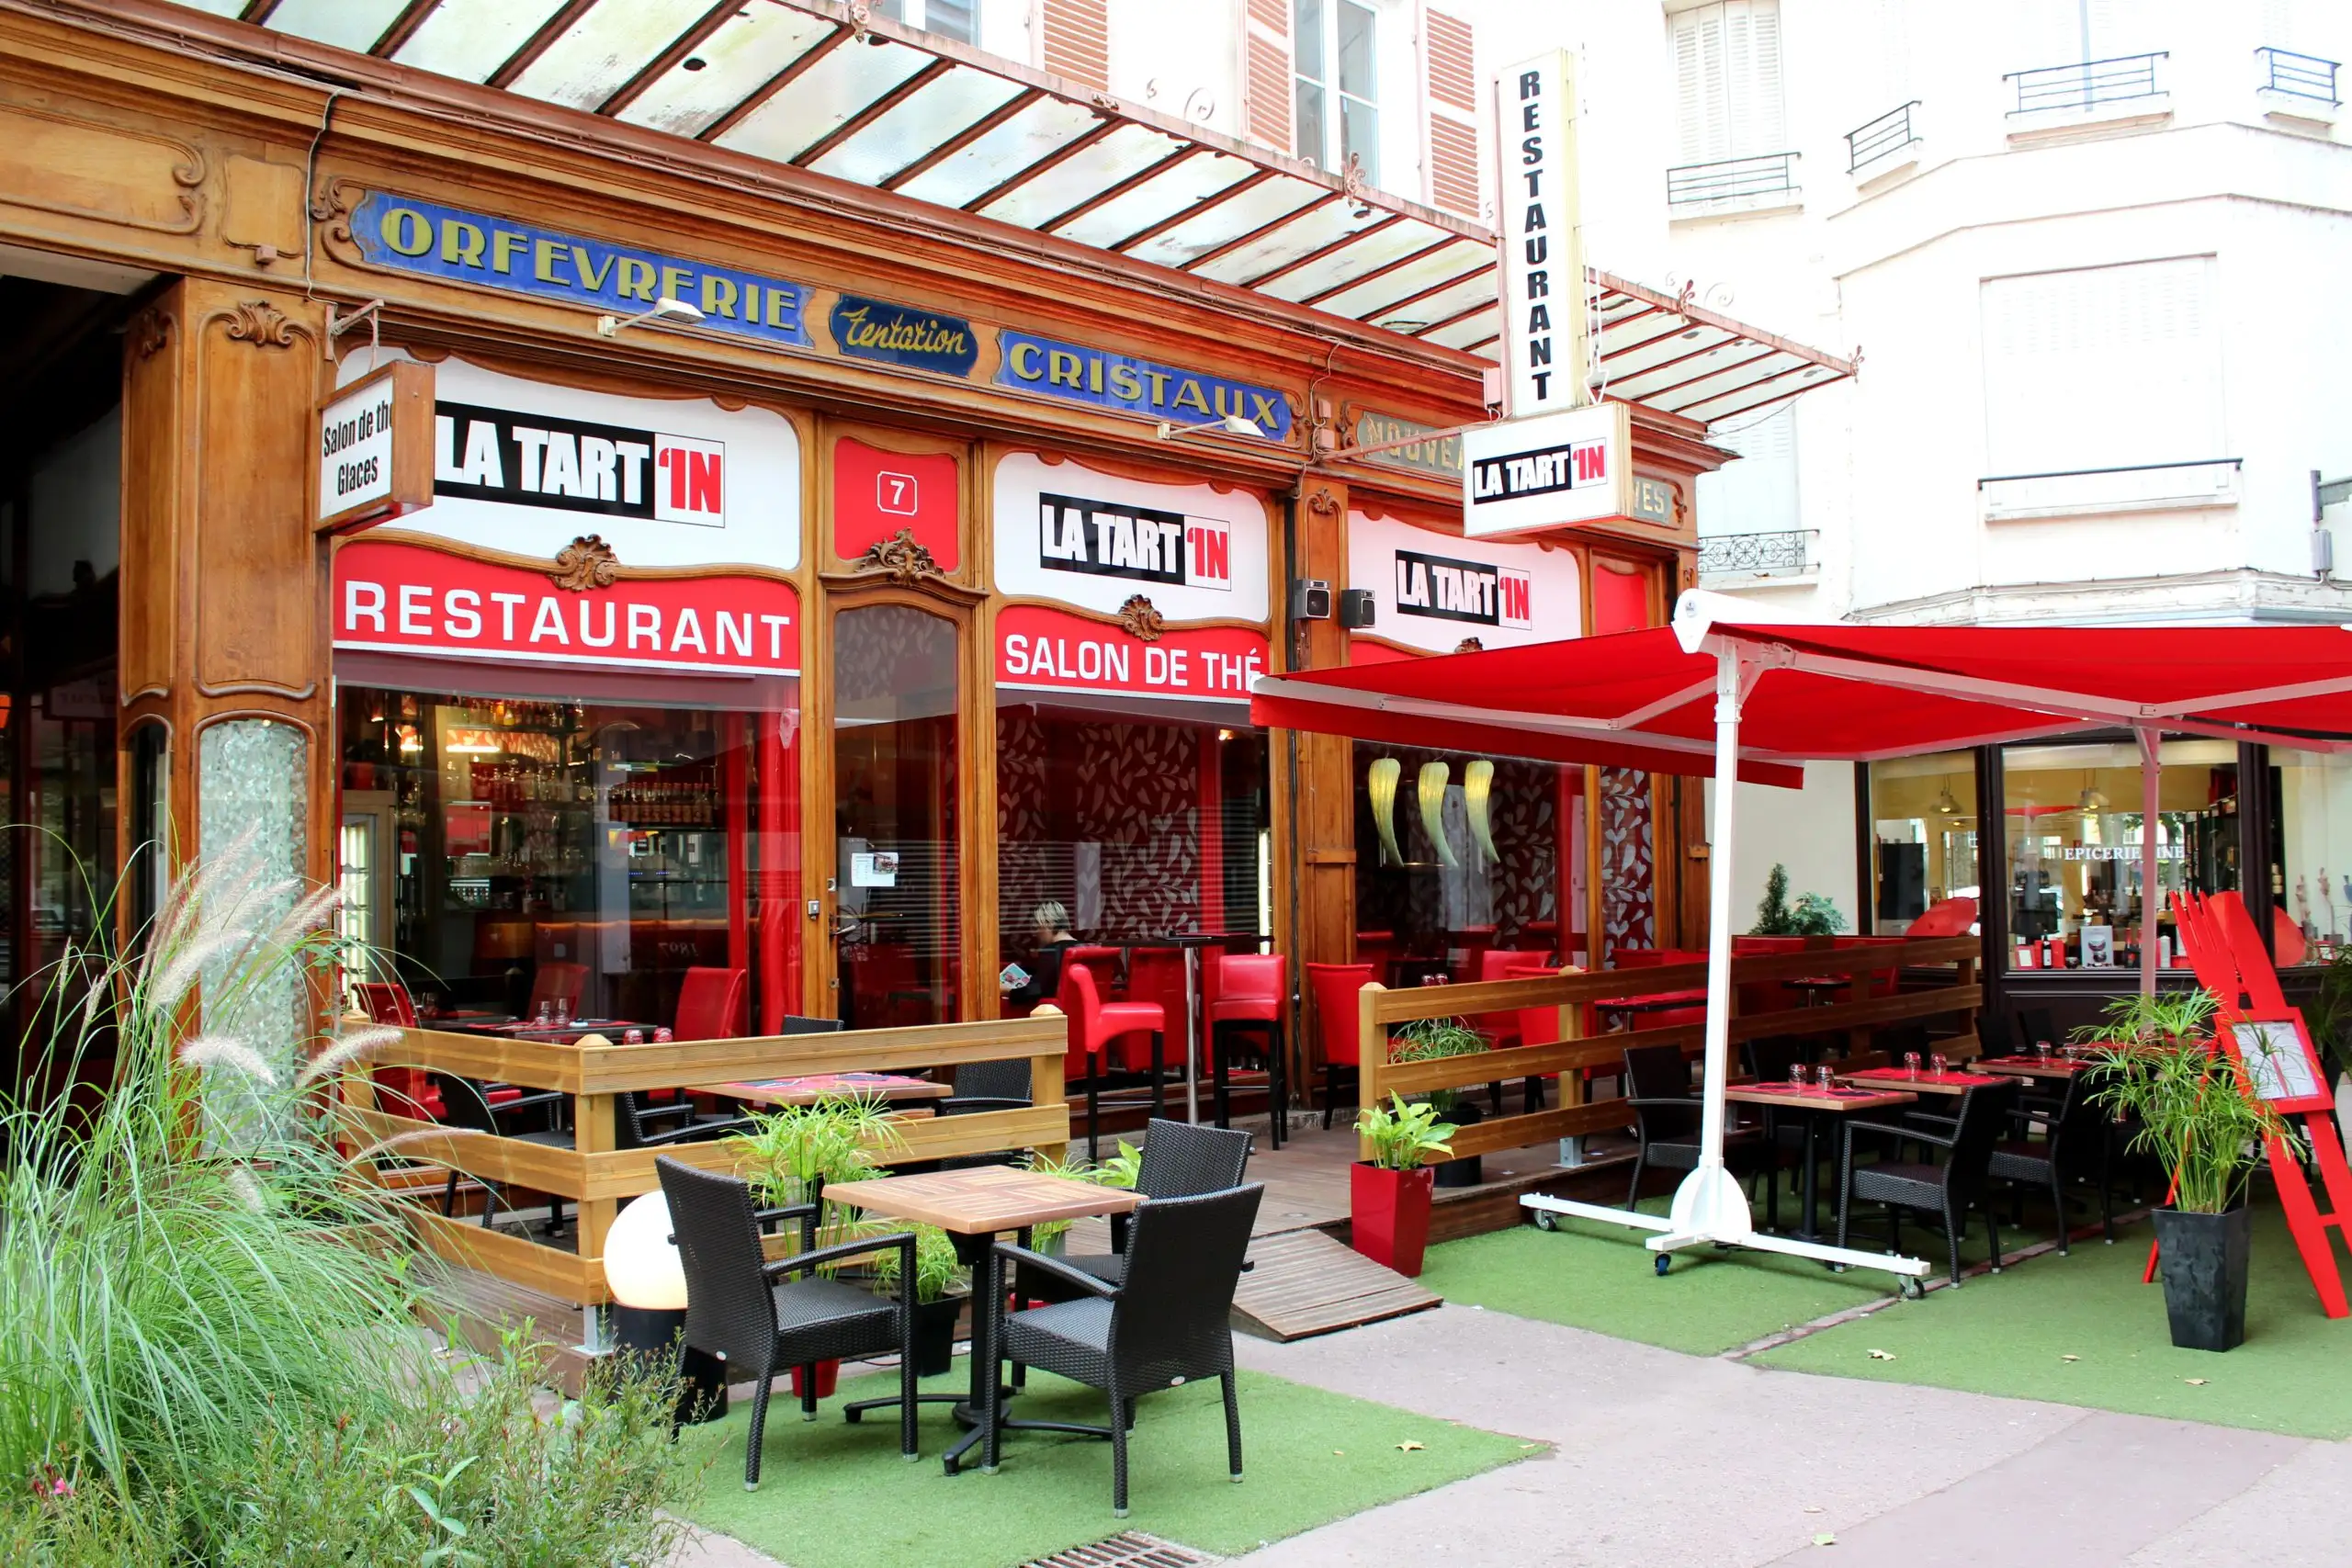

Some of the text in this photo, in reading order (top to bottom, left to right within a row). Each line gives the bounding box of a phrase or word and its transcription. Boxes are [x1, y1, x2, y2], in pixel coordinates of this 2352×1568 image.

[1519, 70, 1552, 400] RESTAURANT
[379, 208, 797, 331] ORFEVRERIE
[839, 305, 967, 356] Tentation
[1010, 341, 1279, 429] CRISTAUX
[323, 419, 356, 457] Salon
[358, 410, 374, 442] de
[434, 414, 504, 488] LA
[1366, 415, 1463, 471] NOUVE
[337, 456, 379, 496] Glaces
[889, 479, 906, 506] 7
[1474, 462, 1504, 499] LA
[1041, 503, 1089, 562] LA
[1396, 558, 1432, 608] LA
[345, 580, 791, 660] RESTAURANT
[1005, 634, 1261, 692] SALON DE THÉ
[2064, 845, 2185, 861] EPICERIE INE
